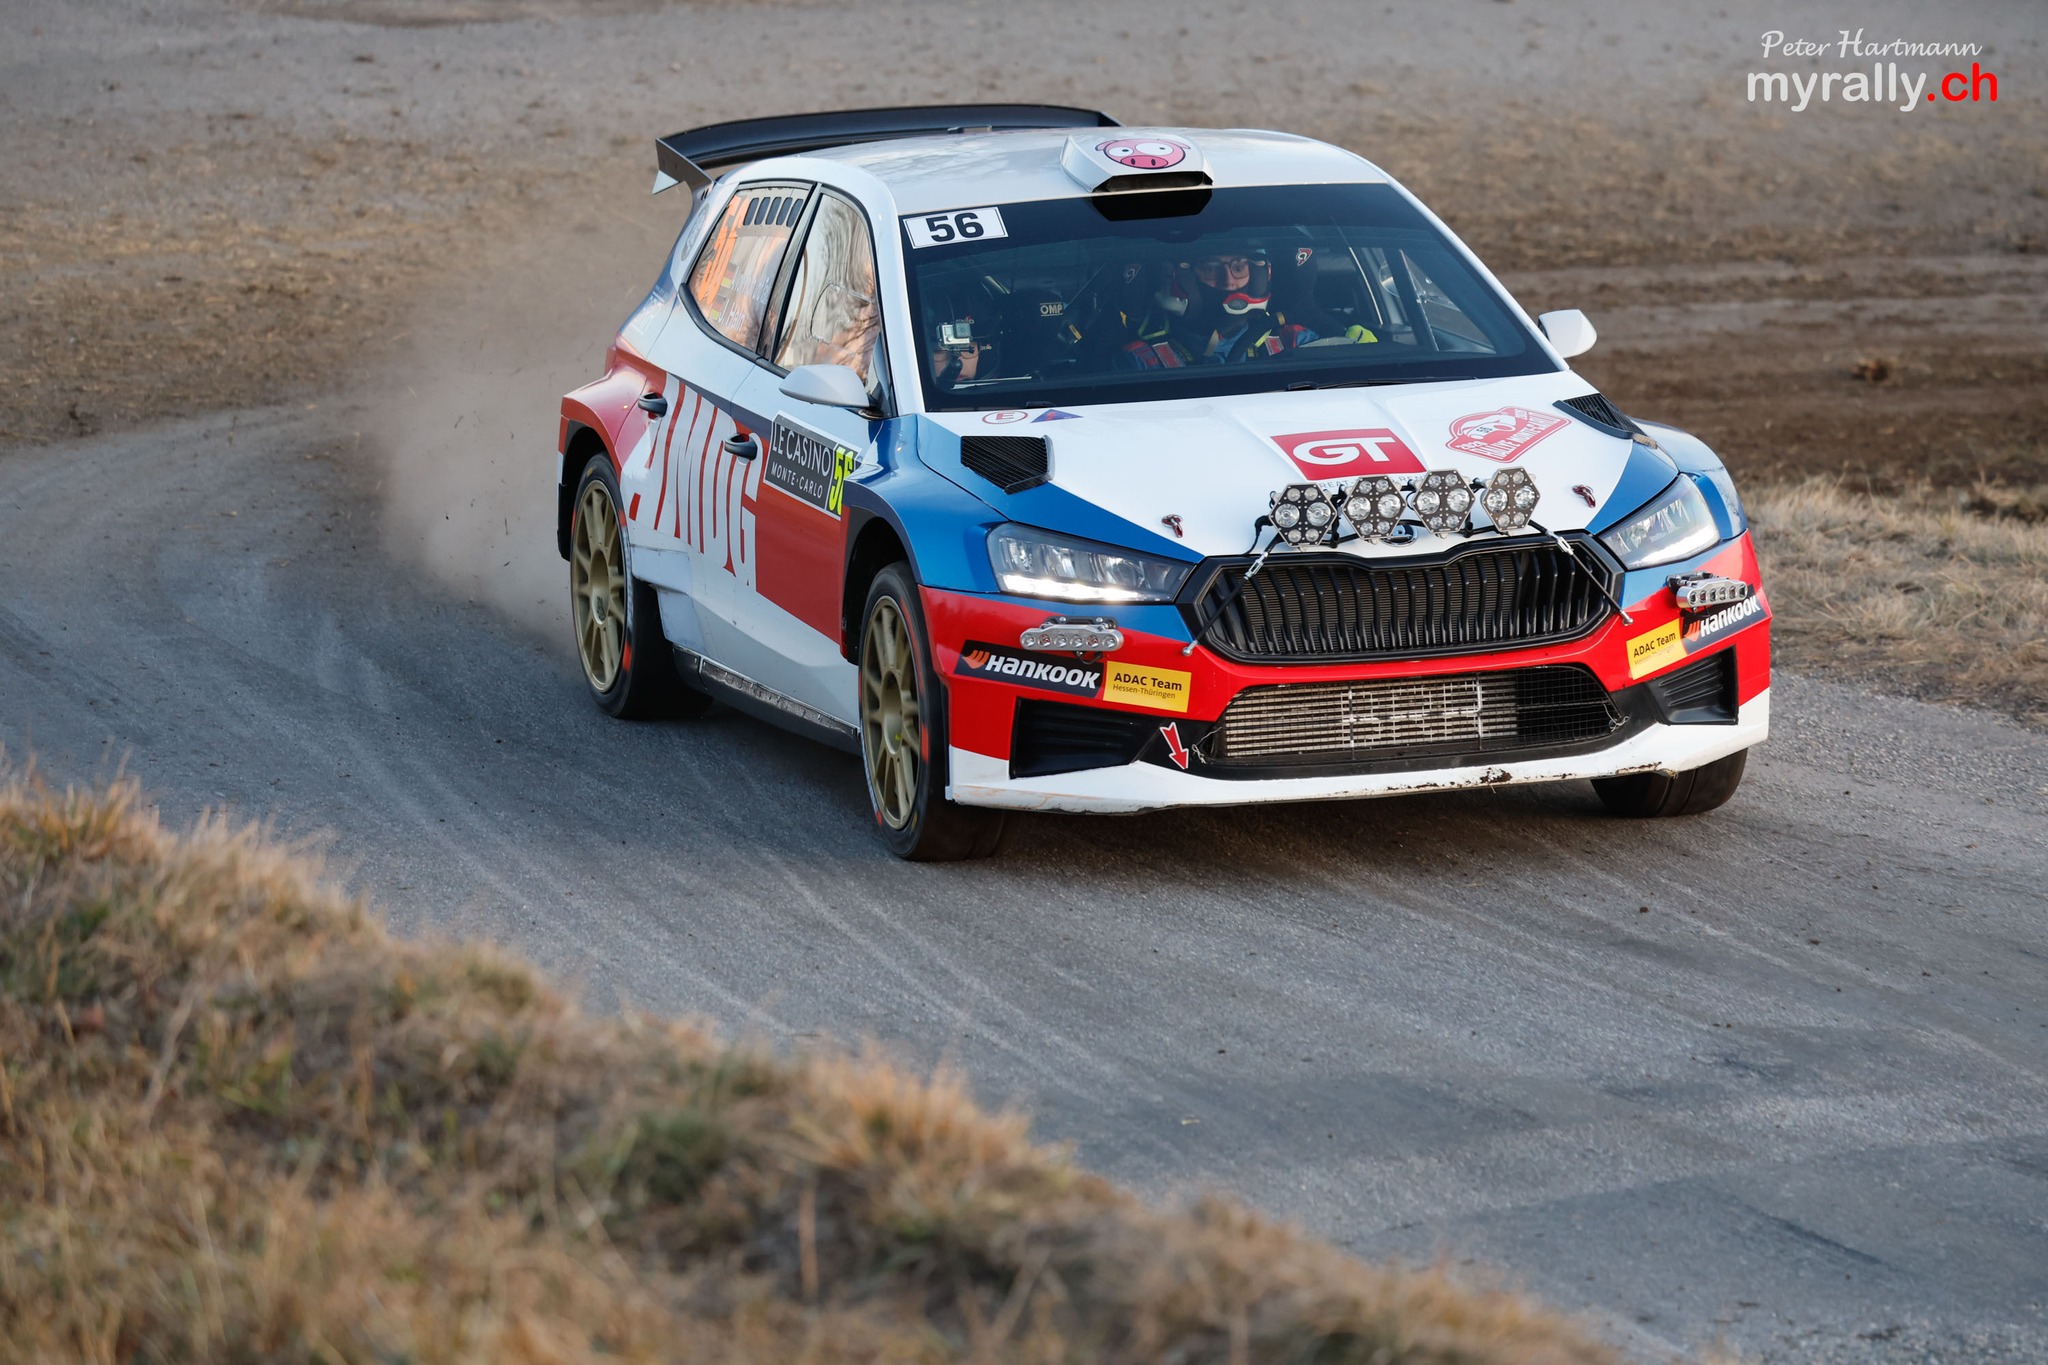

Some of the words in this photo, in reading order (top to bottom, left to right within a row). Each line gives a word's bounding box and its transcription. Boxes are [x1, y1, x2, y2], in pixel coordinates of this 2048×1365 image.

[926, 212, 984, 242] 56
[1040, 303, 1063, 315] OMP
[772, 422, 785, 455] LE
[786, 430, 832, 477] CASINO
[1292, 436, 1397, 466] GT
[1633, 640, 1655, 658] ADAC
[1657, 632, 1676, 646] Team
[1113, 684, 1176, 699] Hessen-Thüringen
[1114, 672, 1147, 686] ADAC
[1151, 677, 1182, 692] Team
